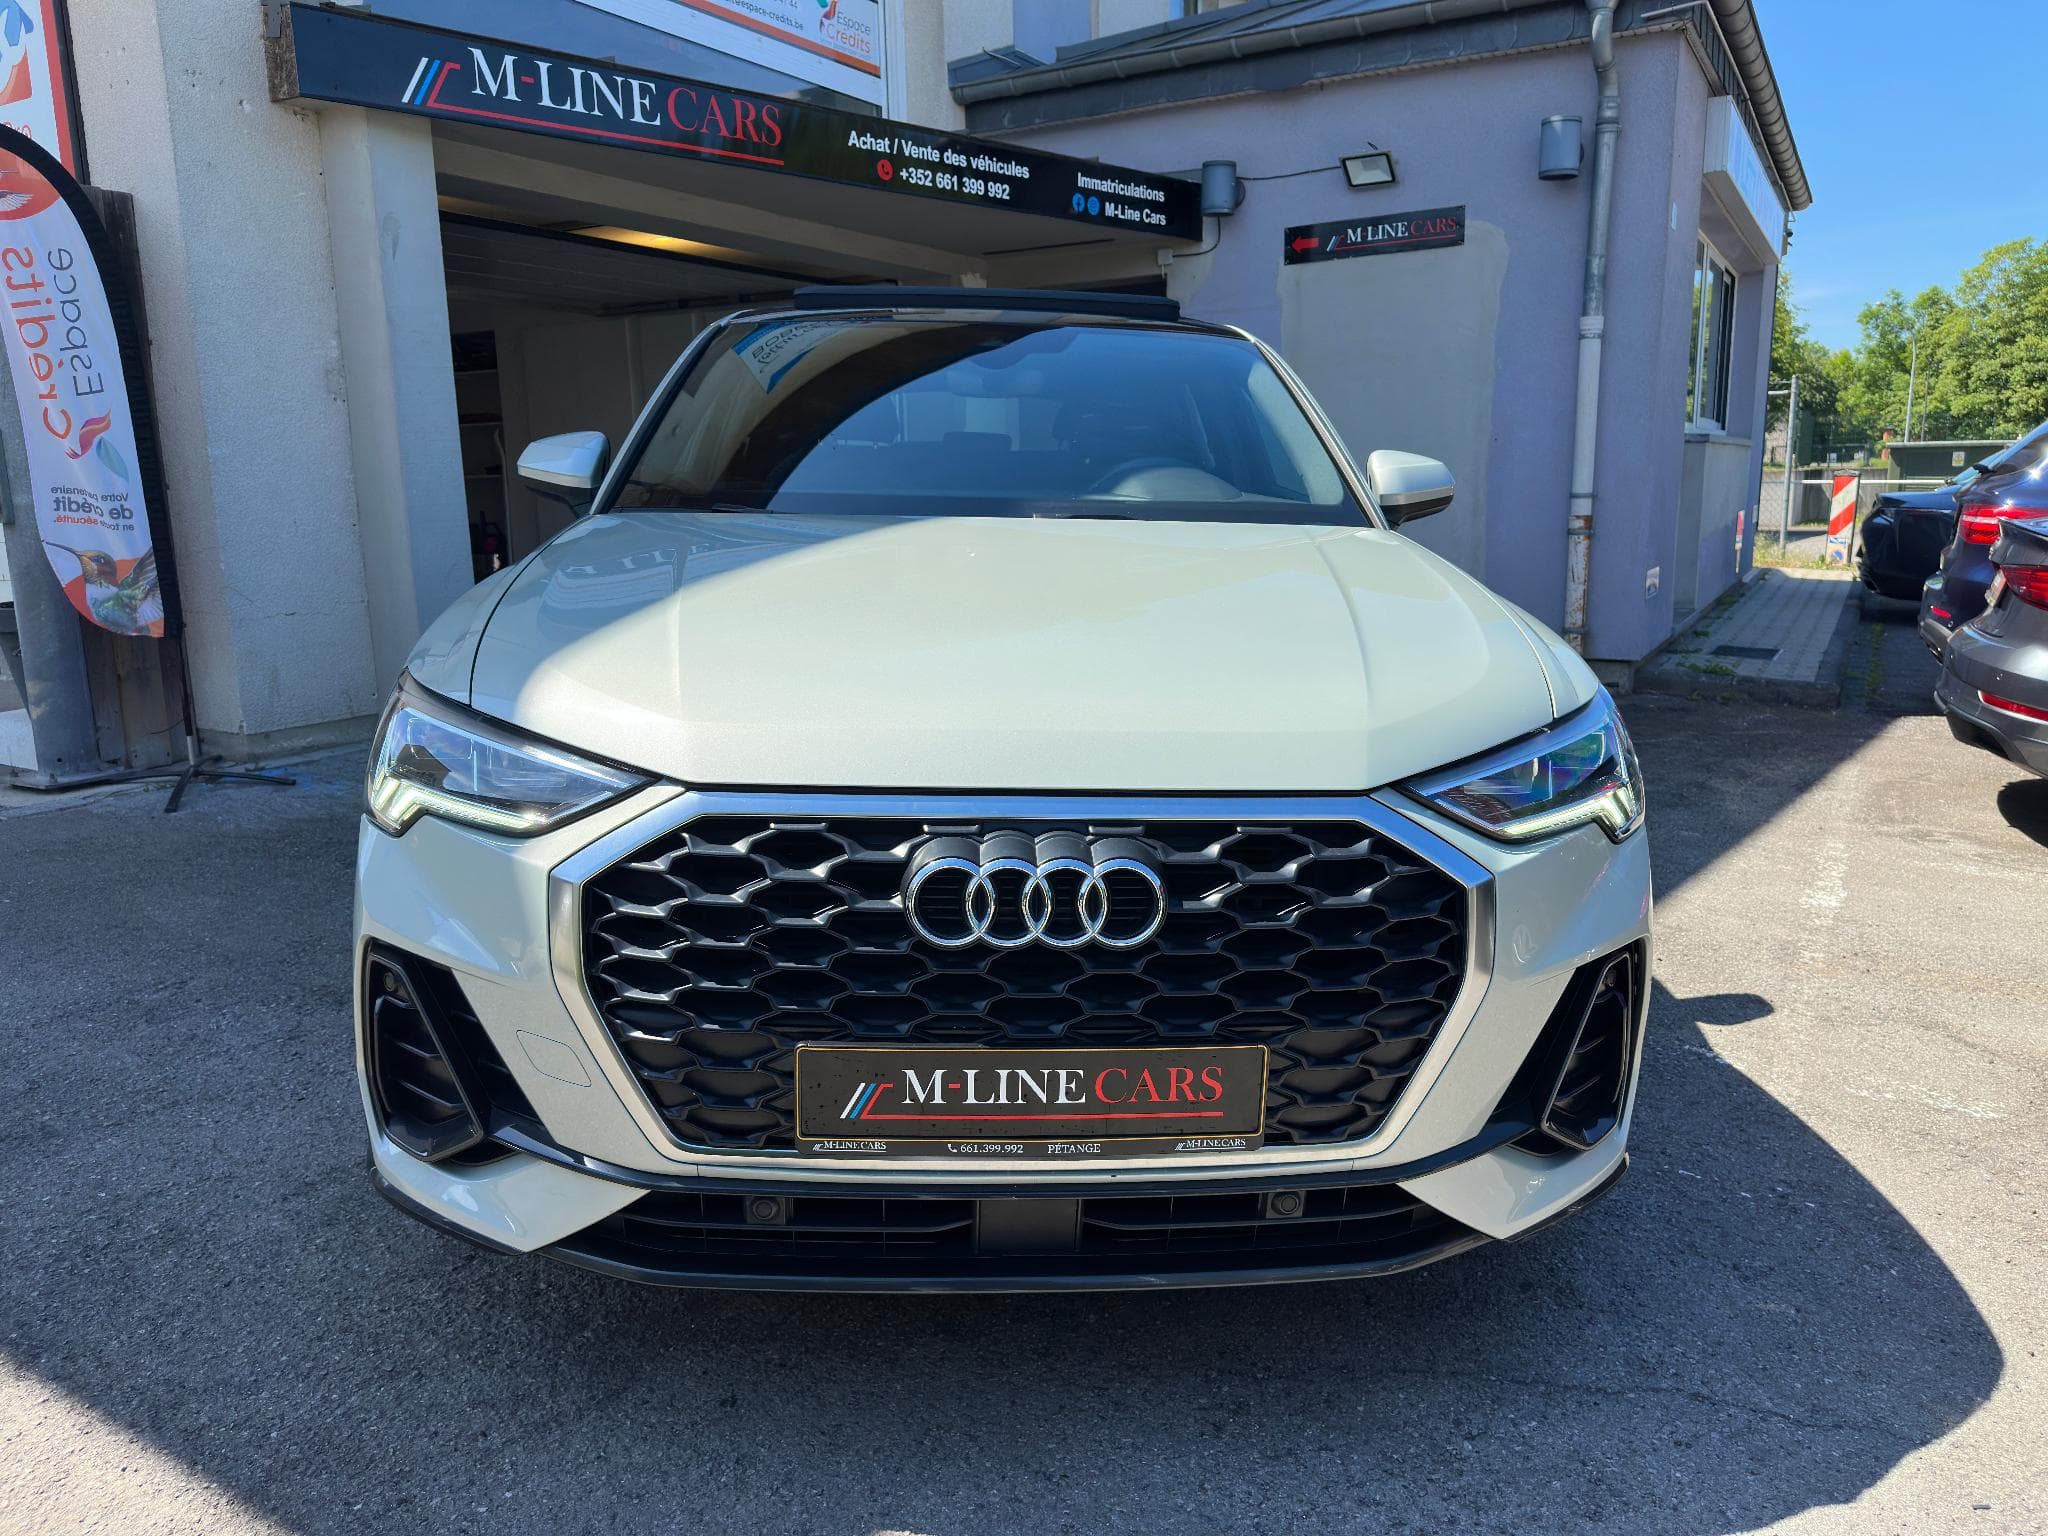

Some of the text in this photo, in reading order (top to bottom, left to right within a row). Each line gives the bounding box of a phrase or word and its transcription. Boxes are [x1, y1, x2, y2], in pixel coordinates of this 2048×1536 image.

[837, 11, 871, 36] Espace
[468, 47, 782, 147] M-LINE CARS
[848, 130, 890, 154] Achat
[901, 139, 940, 162] Vente
[944, 149, 967, 168] des
[970, 154, 1030, 179] véhicules
[900, 166, 1010, 200] +352 661 399 992
[1077, 172, 1165, 202] Immatriculations
[1105, 202, 1166, 226] M-Line Cars
[1411, 216, 1457, 236] CARS
[901, 1067, 1223, 1104] M-LINE CARS
[960, 1143, 1024, 1153] 661.399.992
[1047, 1142, 1101, 1154] PÉTANGE
